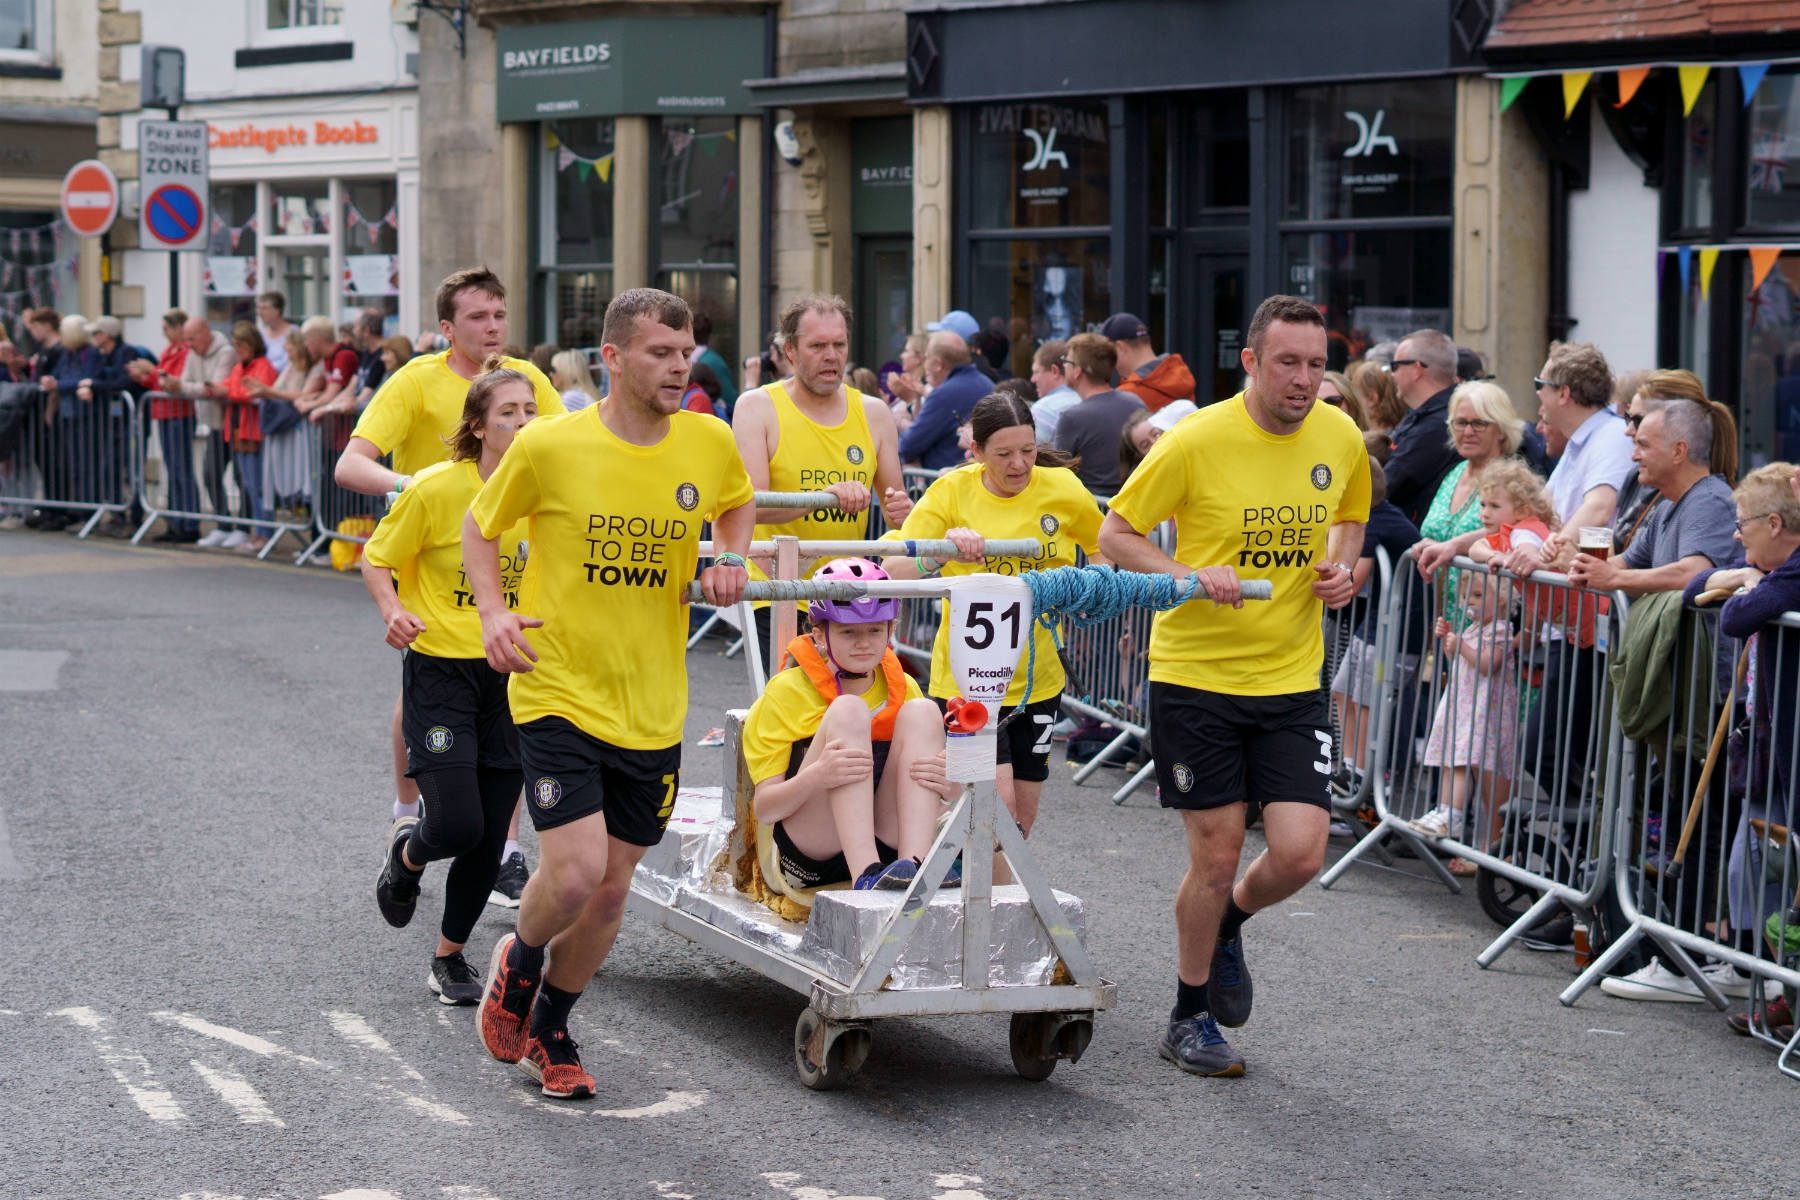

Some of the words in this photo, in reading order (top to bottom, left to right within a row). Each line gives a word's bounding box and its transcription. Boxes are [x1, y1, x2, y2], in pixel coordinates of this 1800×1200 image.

[504, 43, 610, 69] BAYFIELDS
[146, 125, 170, 140] Pay
[175, 125, 201, 139] and
[207, 123, 306, 153] Castlegate
[314, 120, 377, 146] Books
[147, 141, 198, 155] Display
[146, 158, 202, 176] ZONE
[800, 468, 867, 486] PROUD
[1243, 504, 1328, 527] PROUD
[587, 513, 687, 541] PROUD
[1241, 530, 1273, 548] TO
[1280, 528, 1313, 546] BE
[585, 538, 622, 561] TO
[630, 542, 667, 564] BE
[1238, 549, 1314, 569] TOWN
[583, 562, 668, 588] TOWN
[454, 590, 519, 609] TON
[964, 601, 1021, 650] 51
[968, 666, 1014, 679] Piccadilly
